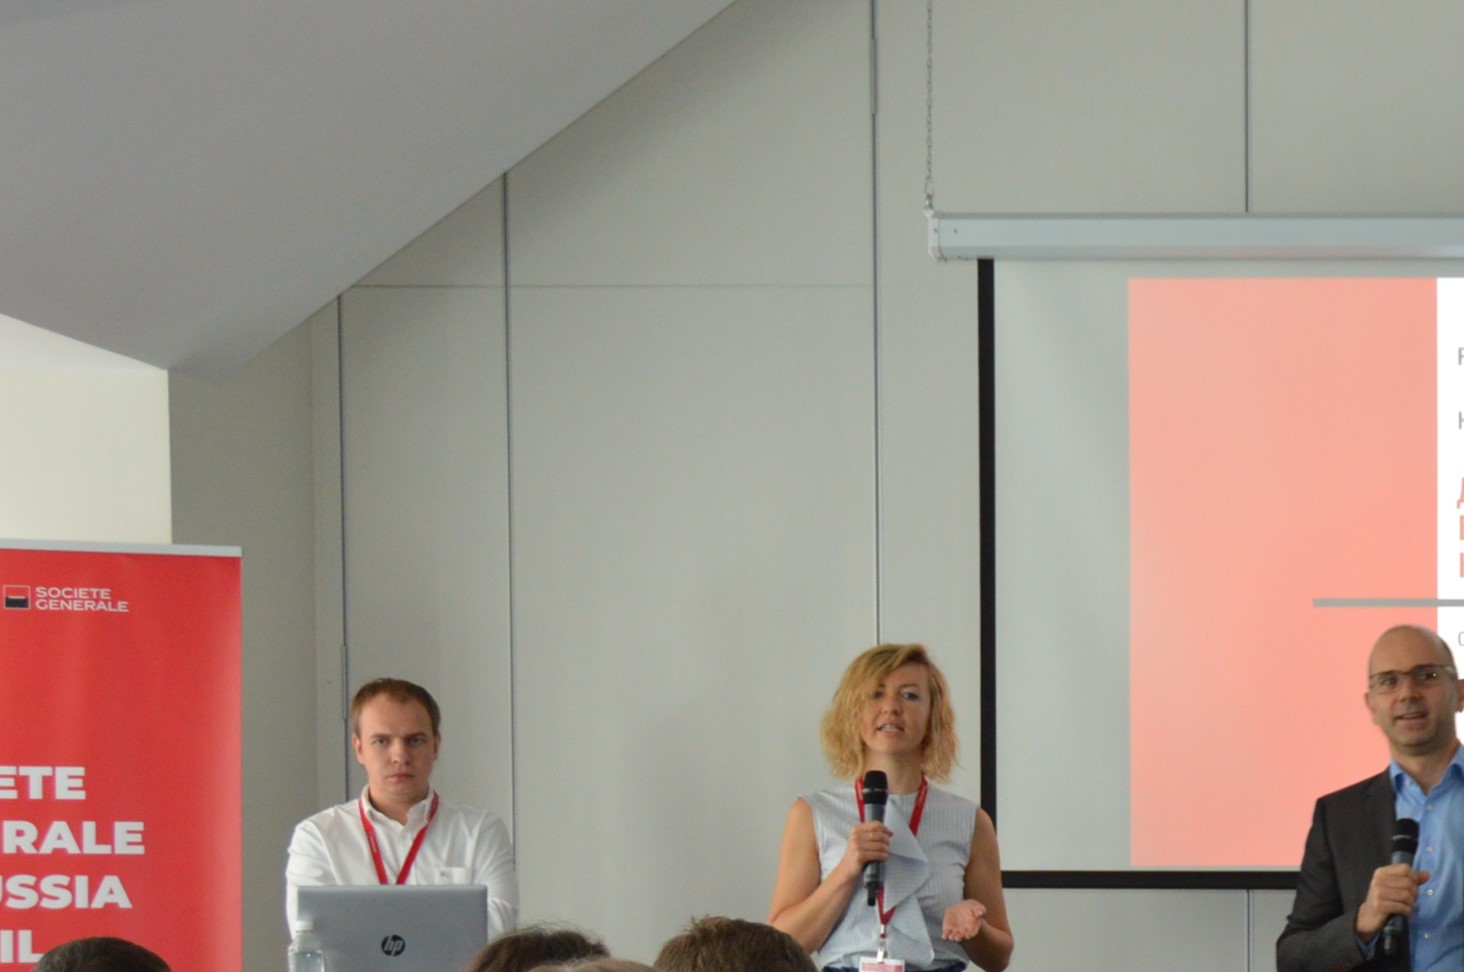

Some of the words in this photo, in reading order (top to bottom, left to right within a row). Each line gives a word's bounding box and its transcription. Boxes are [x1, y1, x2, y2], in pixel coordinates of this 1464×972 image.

[35, 586, 111, 599] SOCIETE
[35, 599, 128, 612] GENERALE
[0, 874, 133, 910] SSIA
[381, 934, 406, 957] hp
